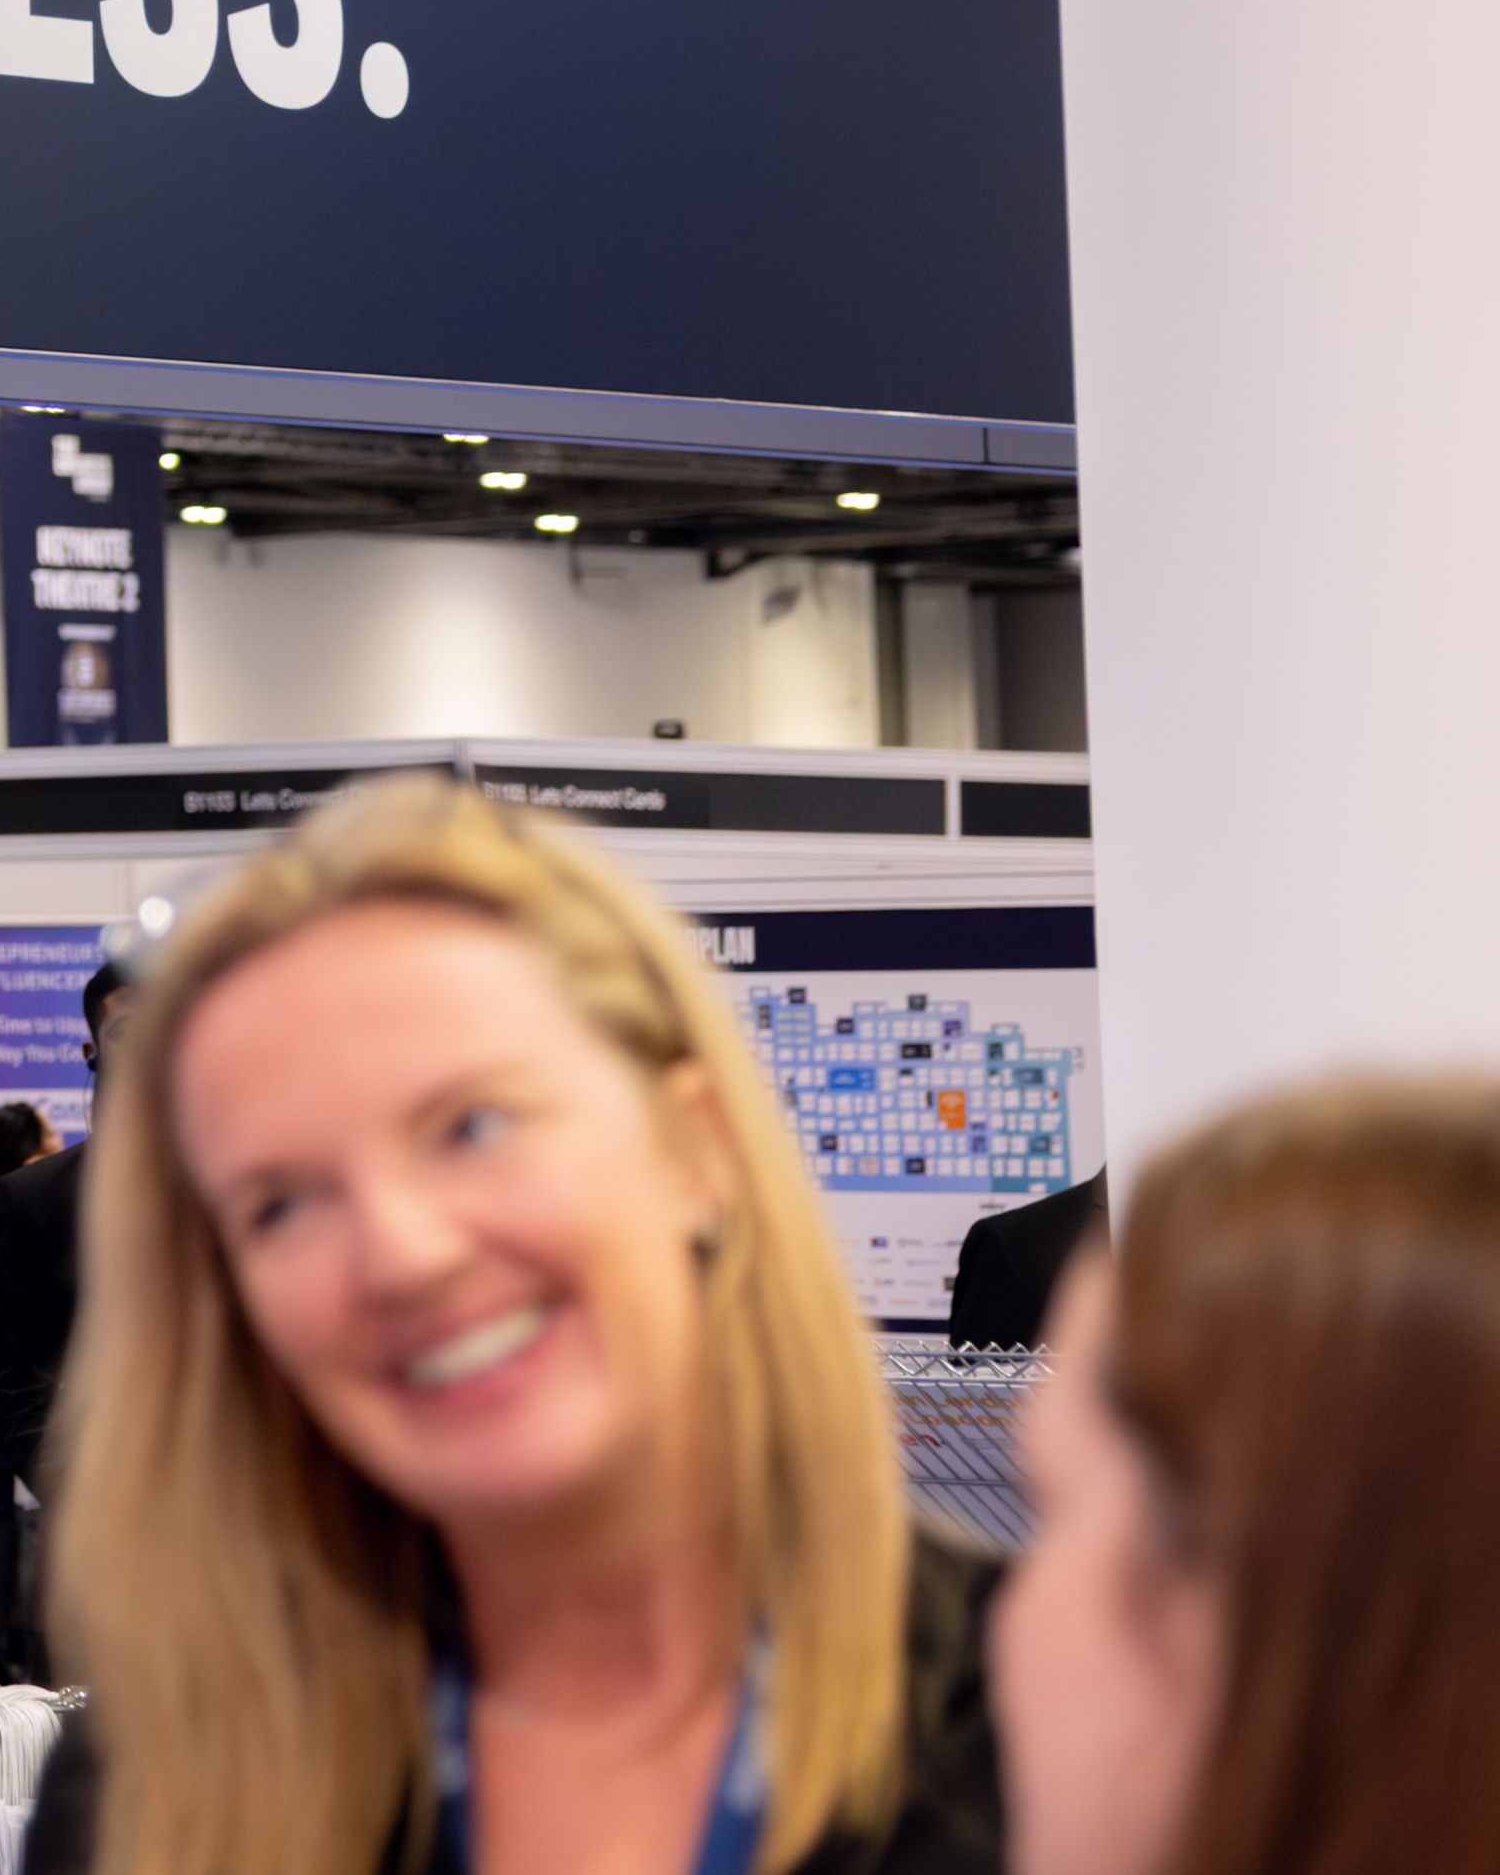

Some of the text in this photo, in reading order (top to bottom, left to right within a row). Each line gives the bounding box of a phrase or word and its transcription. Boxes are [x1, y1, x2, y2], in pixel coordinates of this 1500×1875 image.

[563, 783, 622, 810] Connect
[35, 1016, 51, 1035] to
[26, 1043, 55, 1063] You
